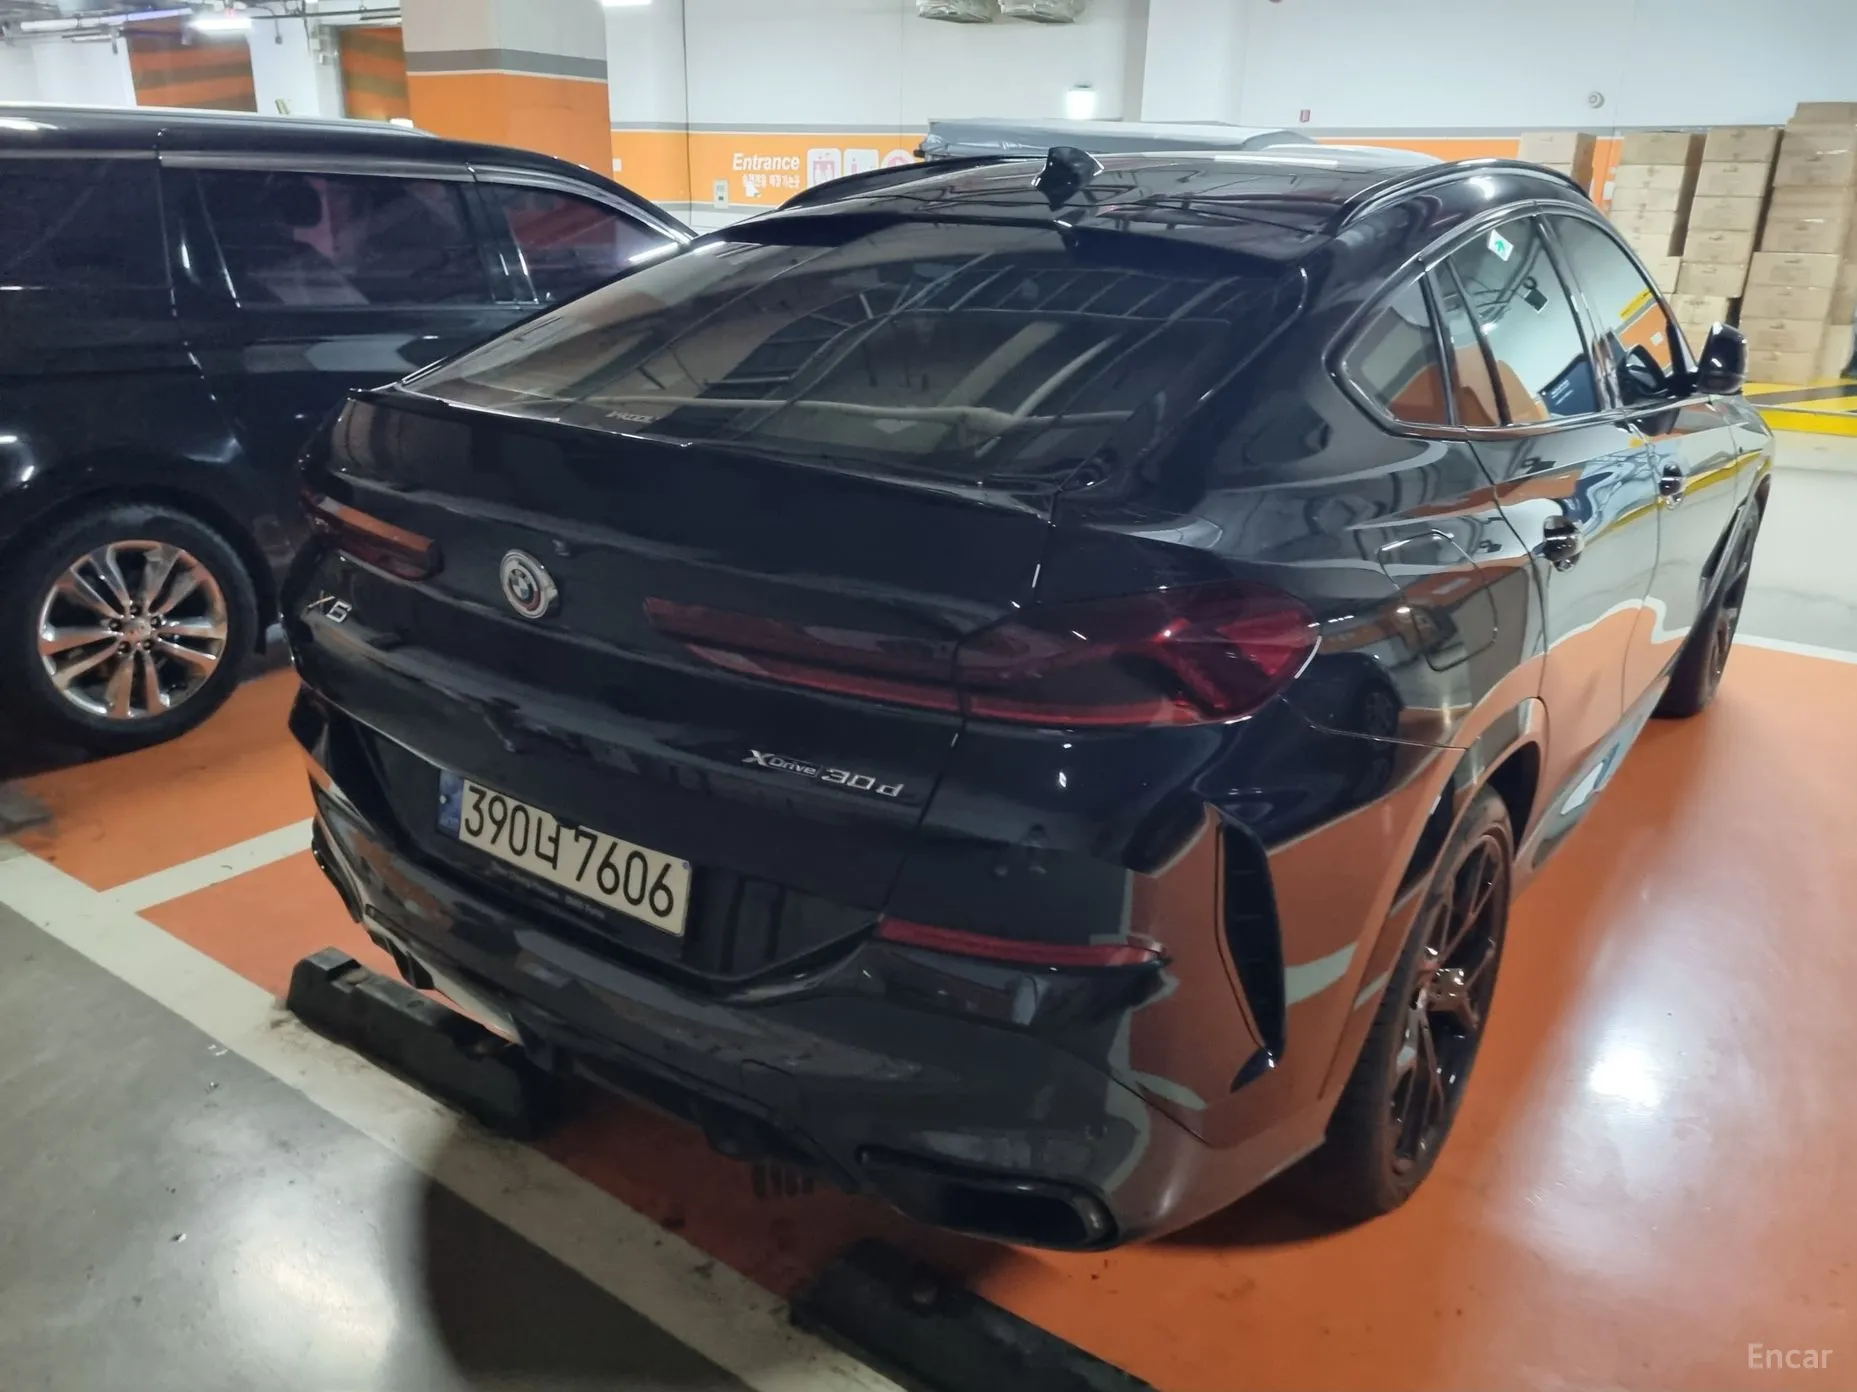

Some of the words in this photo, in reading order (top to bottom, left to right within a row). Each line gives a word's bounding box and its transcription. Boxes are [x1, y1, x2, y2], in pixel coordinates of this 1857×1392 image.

[732, 152, 800, 171] Entrance
[307, 590, 352, 623] X6
[464, 784, 562, 871] 390너
[574, 826, 675, 918] 7606
